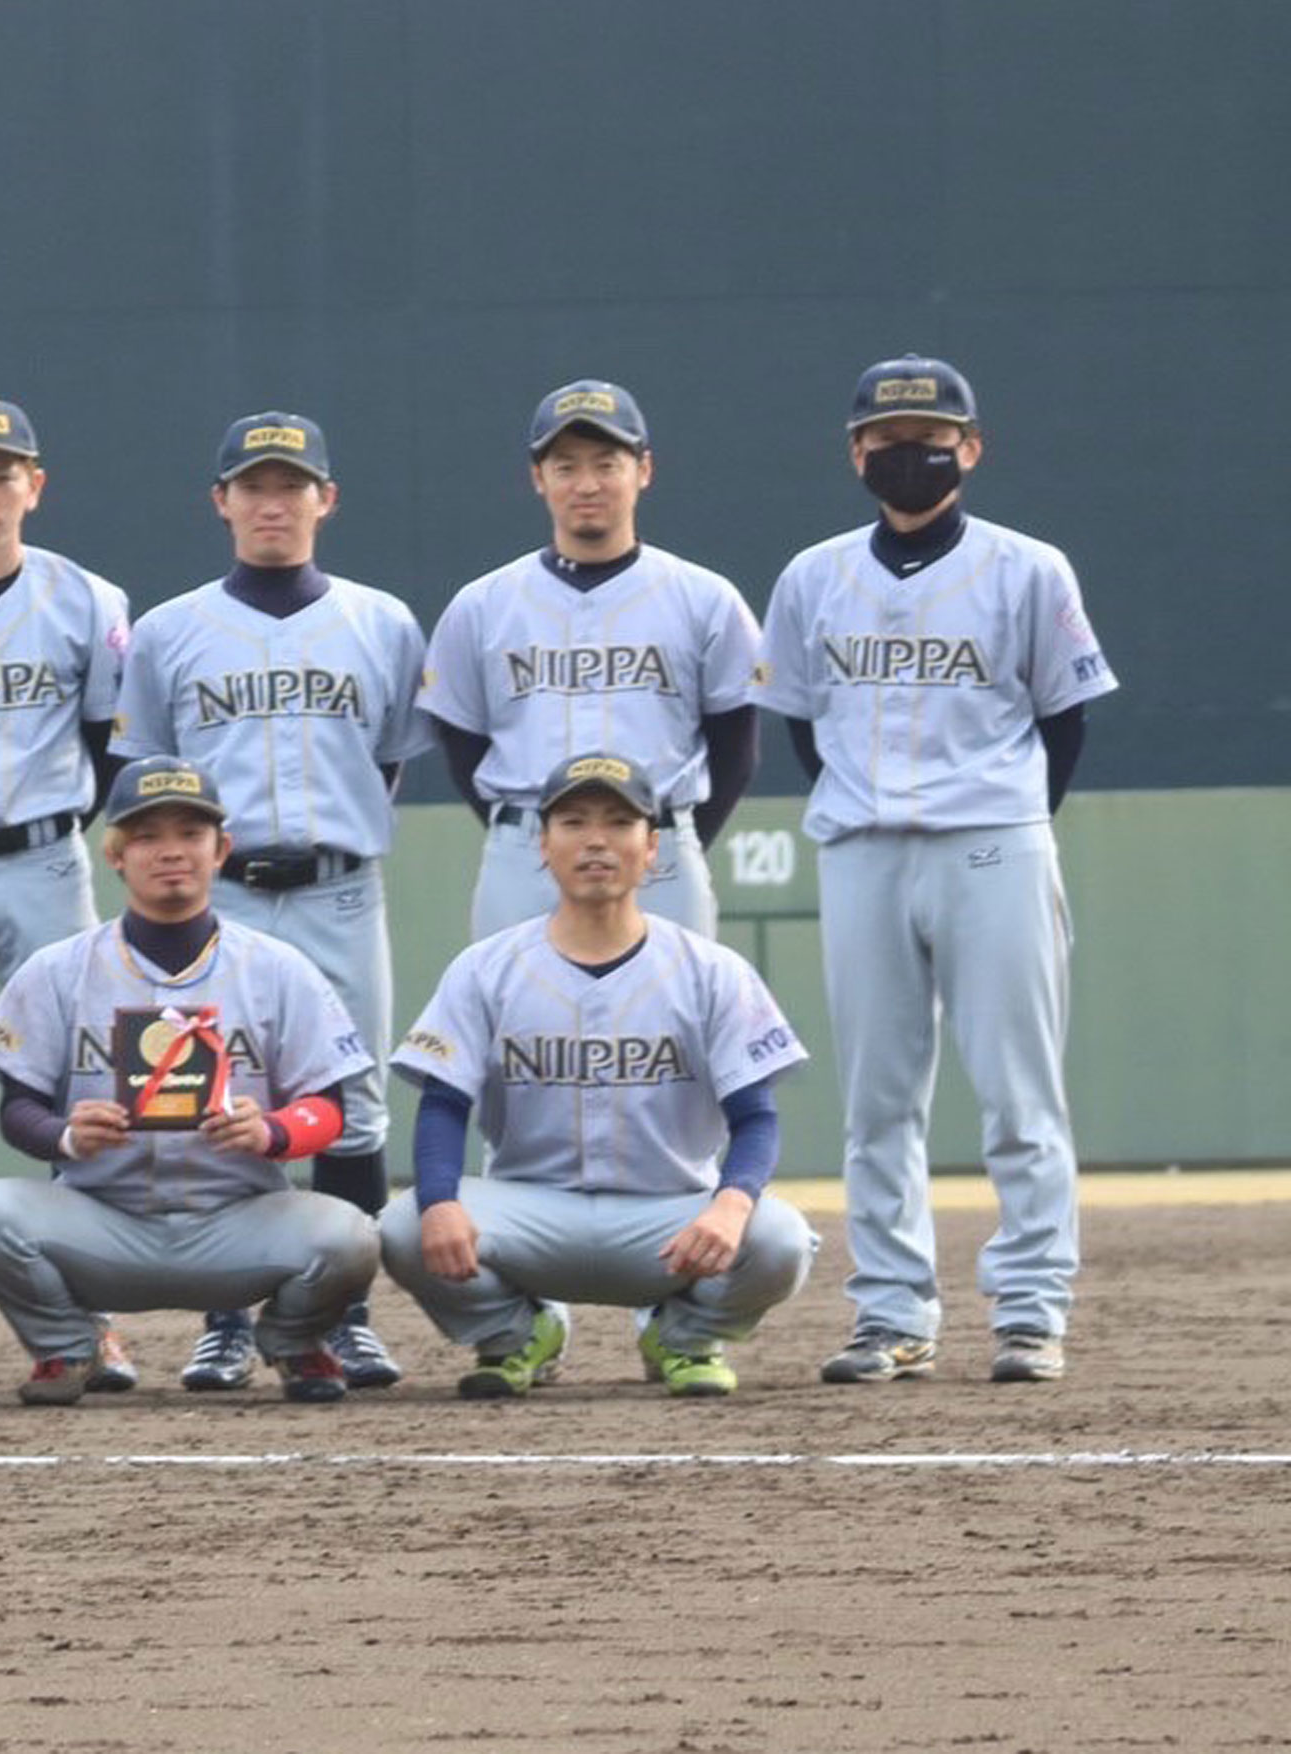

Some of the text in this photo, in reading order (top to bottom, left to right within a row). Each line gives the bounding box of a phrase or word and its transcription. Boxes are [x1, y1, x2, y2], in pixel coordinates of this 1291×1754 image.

[558, 394, 611, 409] NIPPA
[879, 383, 932, 398] NIPPA
[248, 429, 302, 443] NIPPA
[505, 644, 682, 700] NIPPA
[822, 636, 994, 690] NIPPA
[195, 669, 369, 729] NIPPA
[142, 775, 197, 790] NIPPA
[571, 760, 625, 776] NIPPA
[728, 831, 795, 885] 120
[501, 1036, 696, 1086] NIPPA
